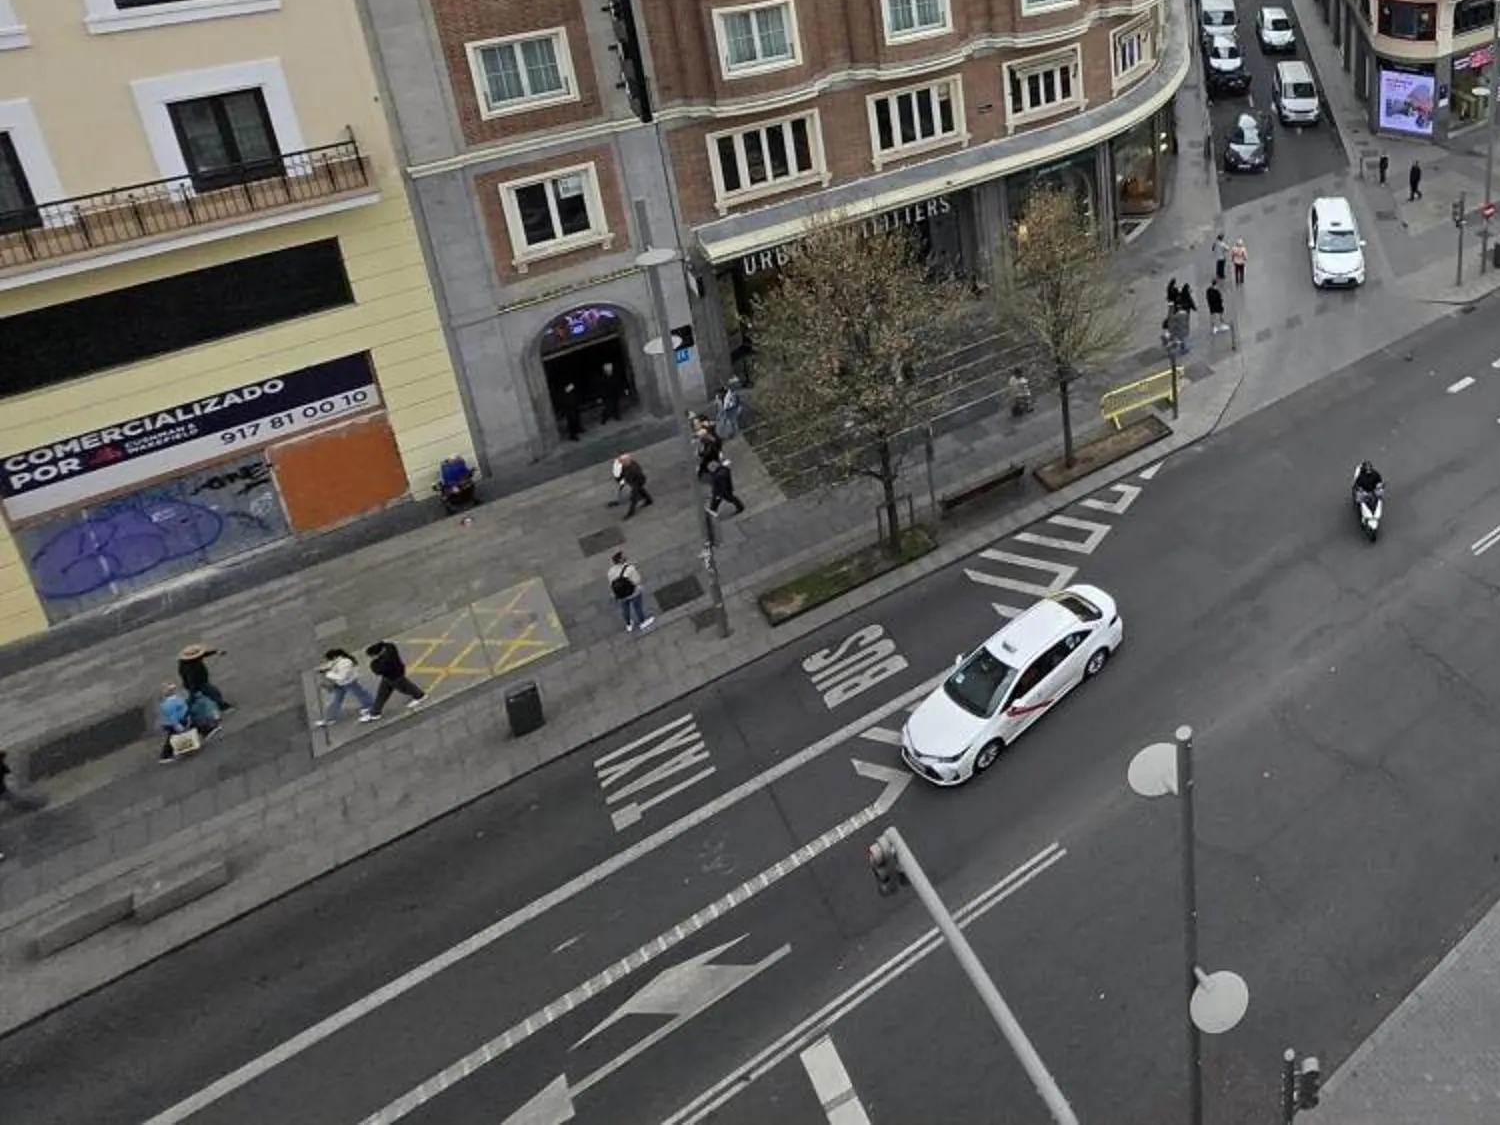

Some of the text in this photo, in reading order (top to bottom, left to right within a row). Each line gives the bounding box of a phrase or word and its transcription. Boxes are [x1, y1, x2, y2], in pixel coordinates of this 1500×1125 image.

[4, 378, 285, 472] COMERCIALIZADO
[220, 390, 368, 445] 917 81 00 10
[9, 457, 82, 490] POR
[802, 624, 909, 710] BUS
[593, 712, 718, 833] TAXI
